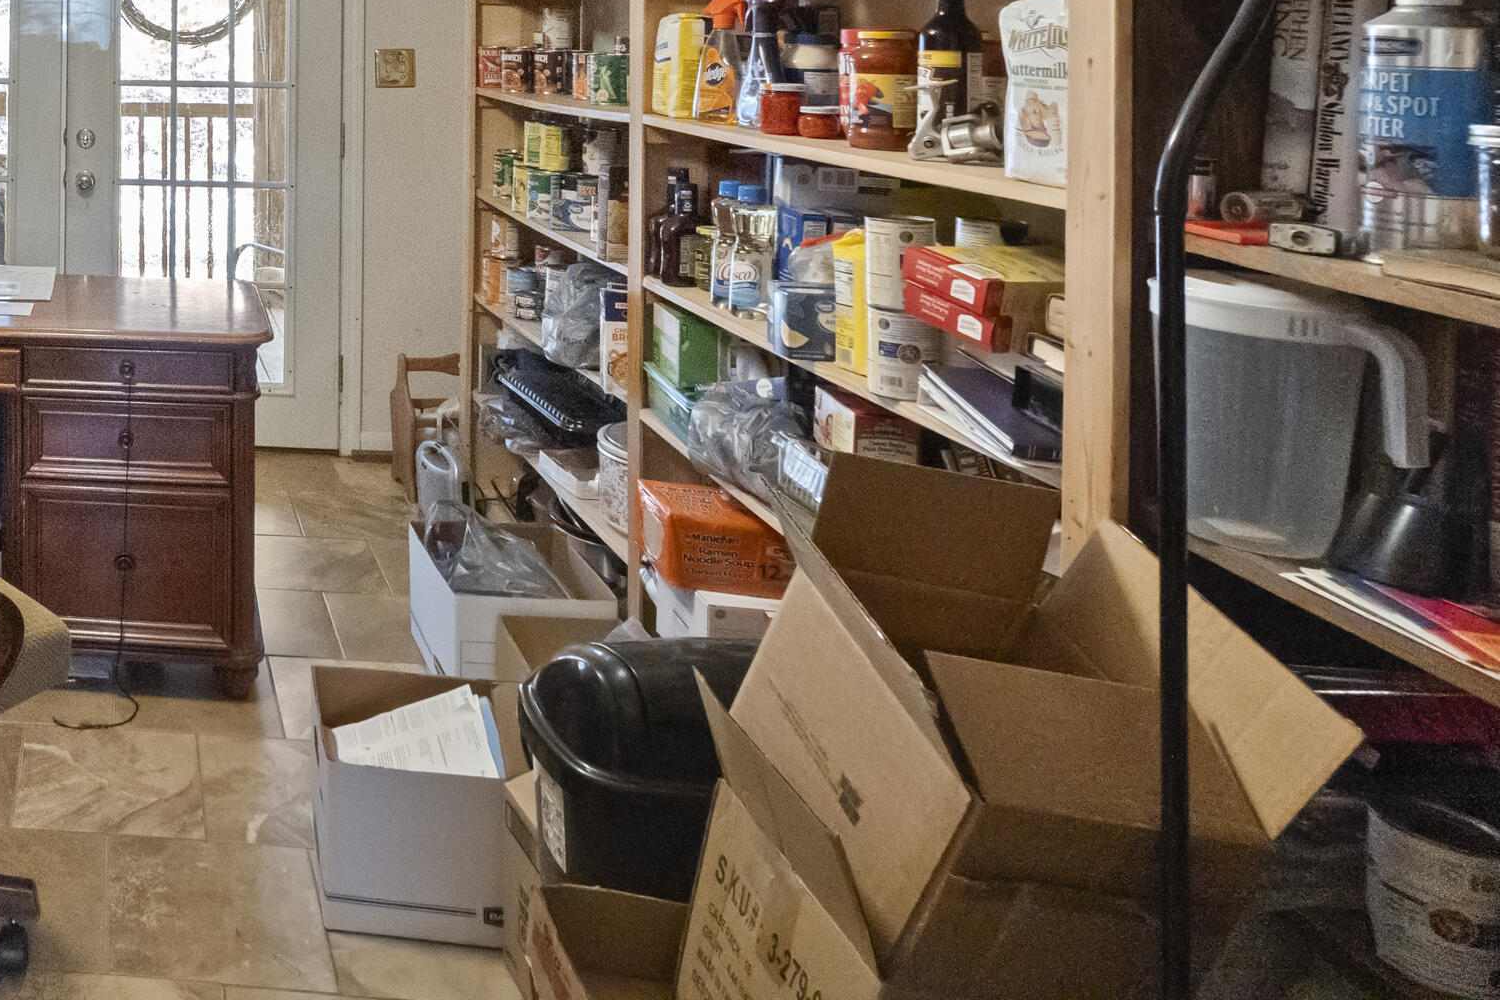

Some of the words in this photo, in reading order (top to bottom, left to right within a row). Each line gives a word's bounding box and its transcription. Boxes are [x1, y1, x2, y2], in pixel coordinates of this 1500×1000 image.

[1011, 61, 1067, 79] uttermilk
[1360, 72, 1412, 93] ARPET
[1385, 96, 1440, 118] SPOT
[692, 534, 739, 545] Maruchan
[699, 547, 738, 558] Ramen
[683, 554, 723, 565] Noodle
[724, 557, 755, 569] Soup
[684, 567, 723, 577] Chicken
[758, 565, 781, 581] 12
